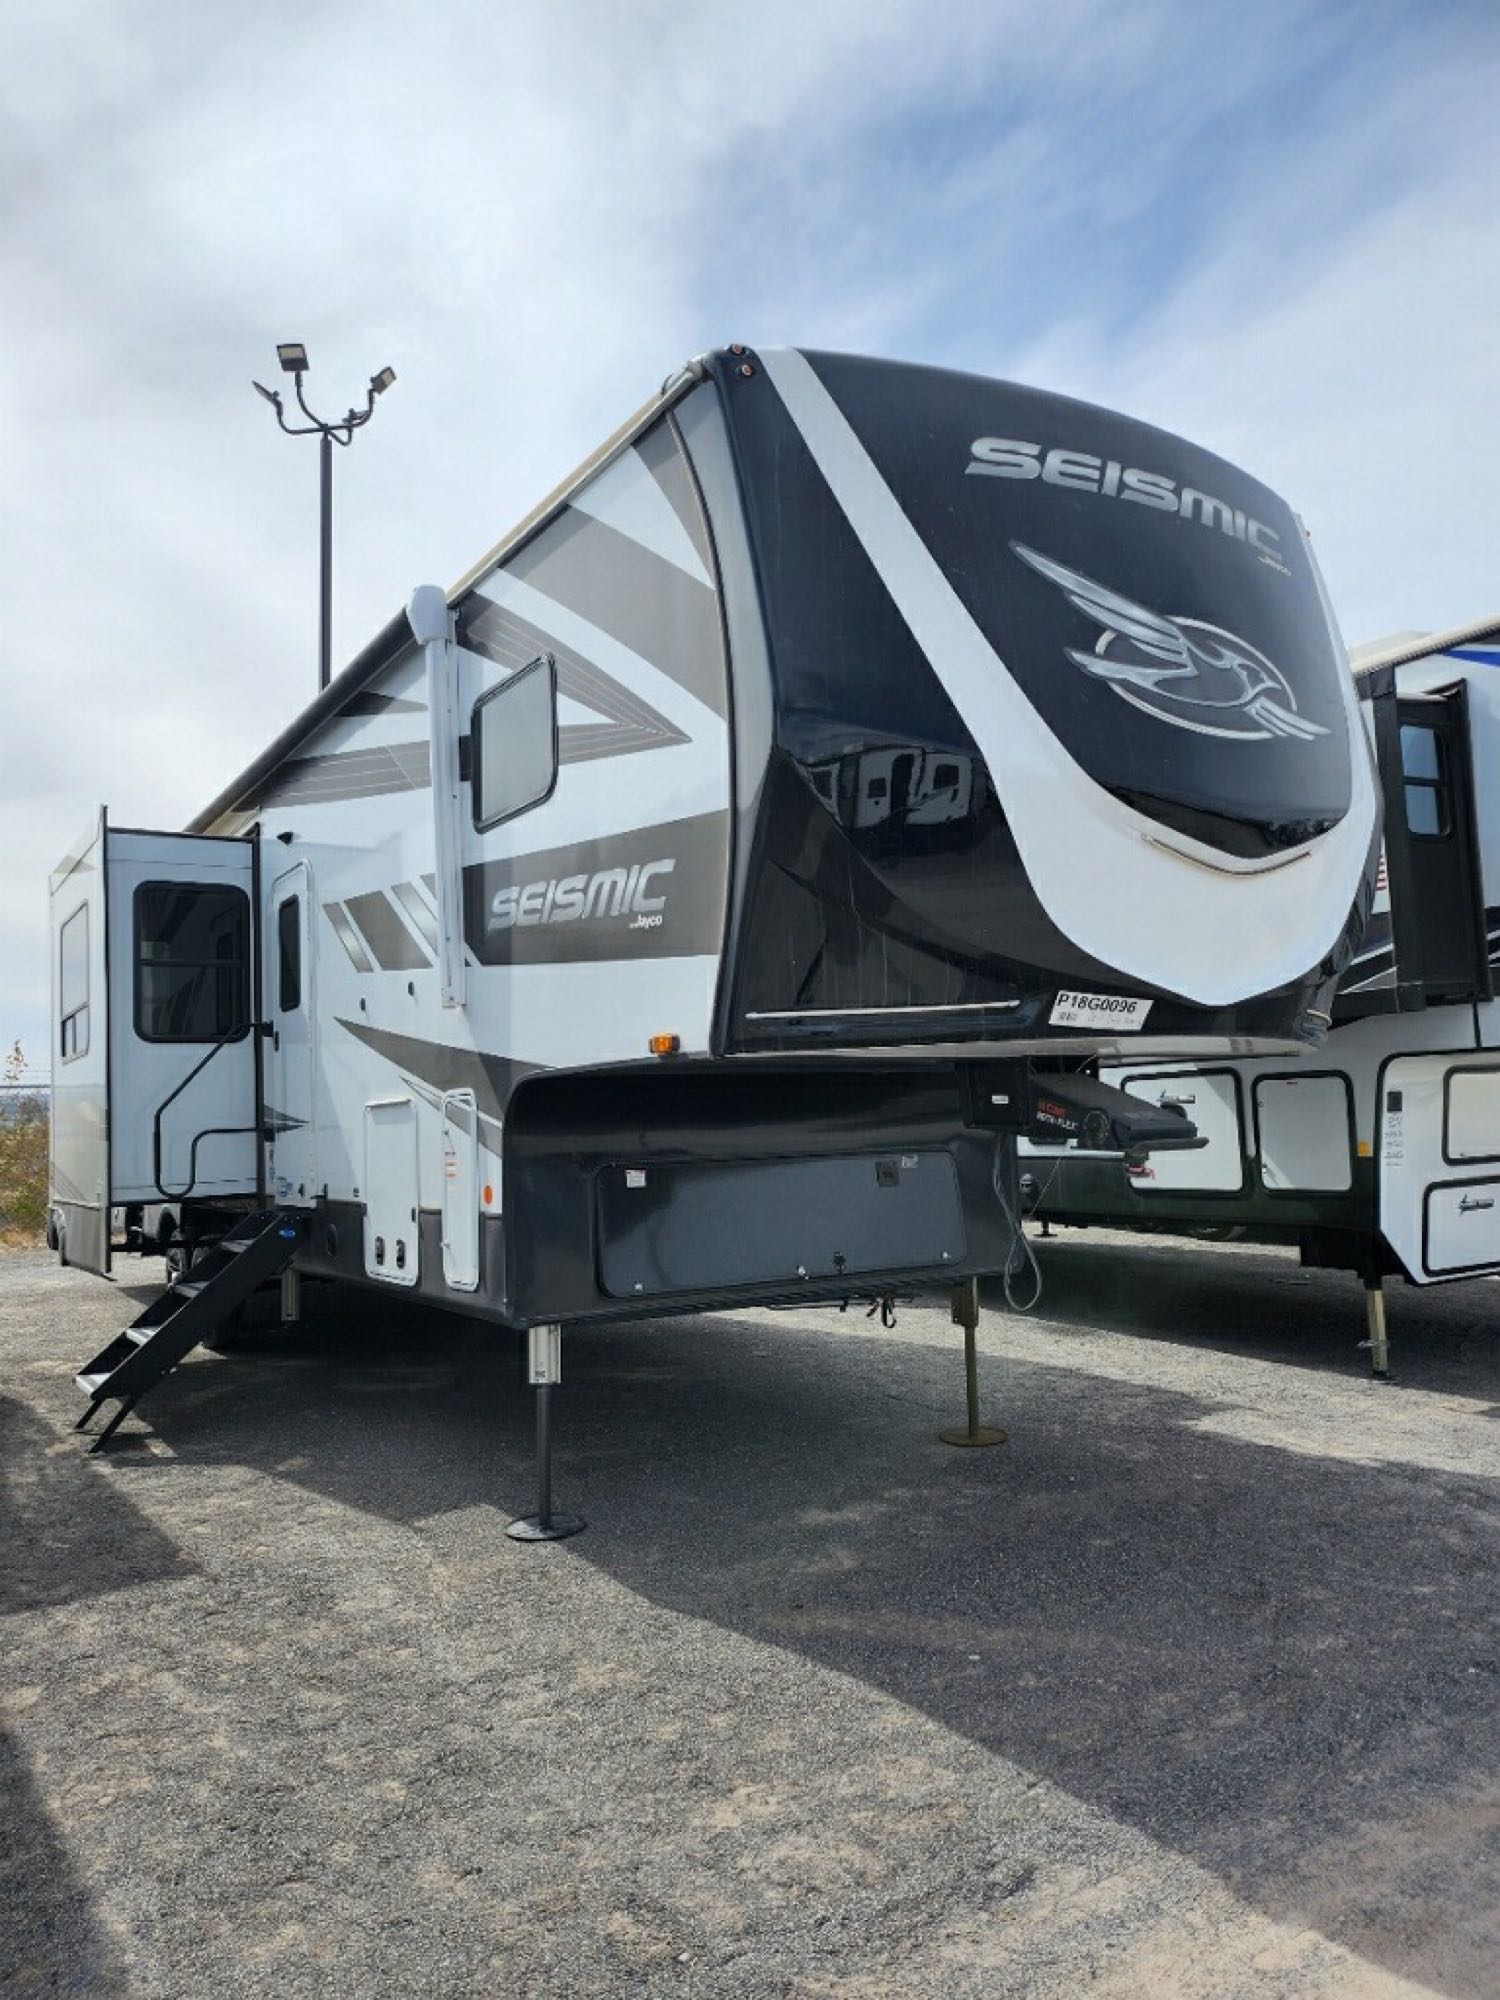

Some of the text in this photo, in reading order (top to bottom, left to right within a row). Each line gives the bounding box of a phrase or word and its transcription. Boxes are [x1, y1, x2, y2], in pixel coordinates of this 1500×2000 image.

[964, 437, 1282, 559] SEISMIC
[488, 858, 676, 931] SEISMIC
[1056, 993, 1138, 1014] P18G0096
